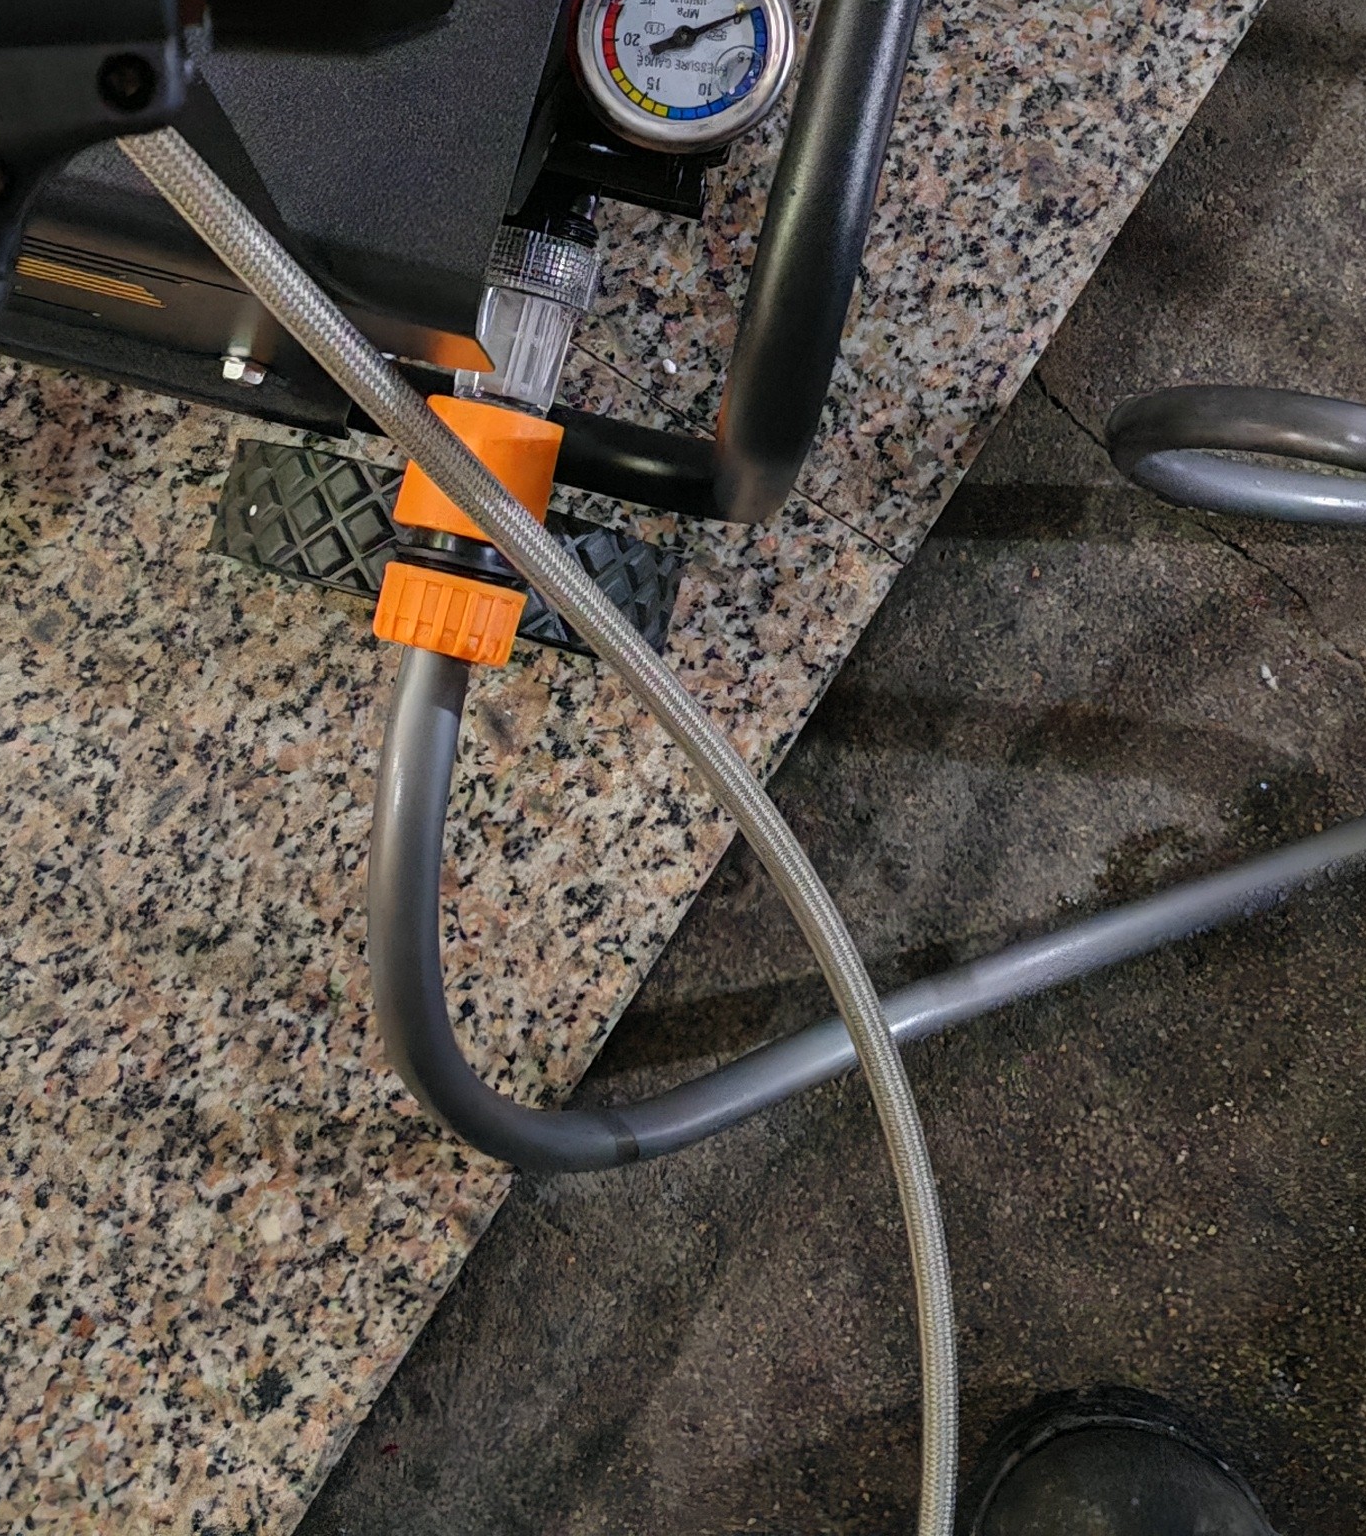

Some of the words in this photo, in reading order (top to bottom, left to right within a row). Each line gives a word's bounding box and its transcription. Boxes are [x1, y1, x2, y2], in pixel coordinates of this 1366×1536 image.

[623, 32, 640, 47] 20
[646, 77, 661, 91] 15
[698, 83, 712, 96] 10
